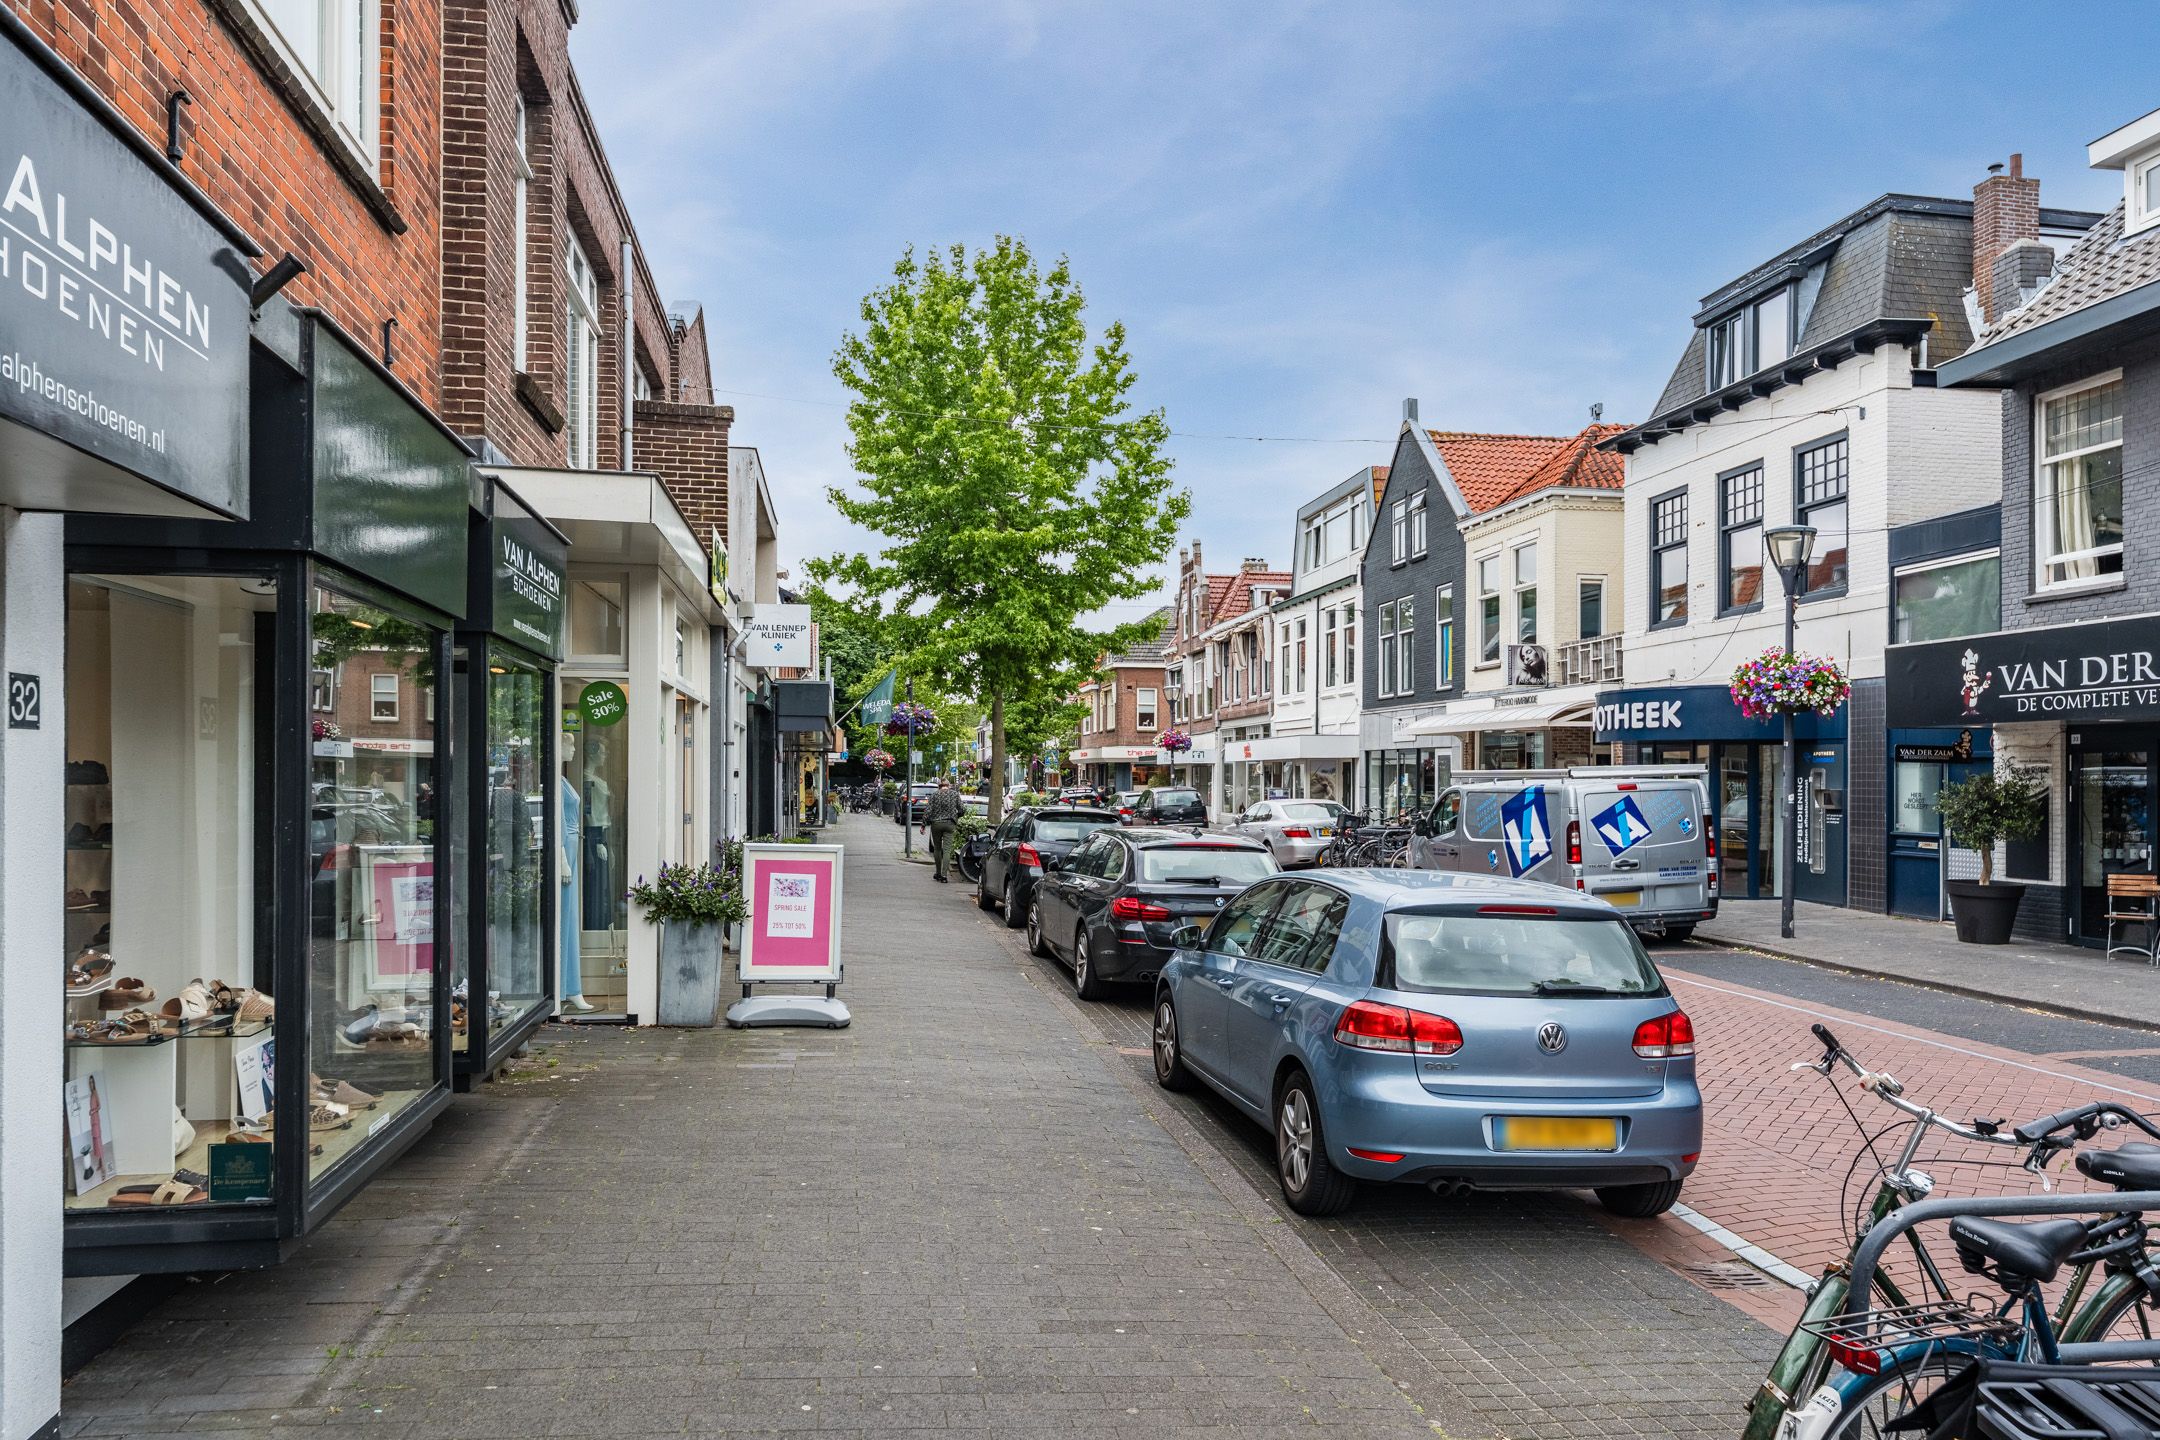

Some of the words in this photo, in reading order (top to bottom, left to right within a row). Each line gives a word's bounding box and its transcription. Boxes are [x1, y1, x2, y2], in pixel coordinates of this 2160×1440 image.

[2, 154, 210, 349] ALPHEN
[503, 535, 524, 570] VAN
[526, 551, 560, 595] ALPHEN
[513, 574, 552, 612] SCHOENEN
[771, 624, 807, 632] LENNEP
[1998, 659, 2067, 692] VAN
[2079, 651, 2160, 686] DER
[11, 680, 38, 721] 32
[586, 690, 614, 706] Sale
[863, 699, 891, 710] WELEDA
[2017, 697, 2038, 712] DE
[2041, 691, 2130, 711] COMPLETE
[2134, 689, 2160, 705] VE
[591, 702, 620, 719] 30%
[1424, 1061, 1460, 1071] GOLF
